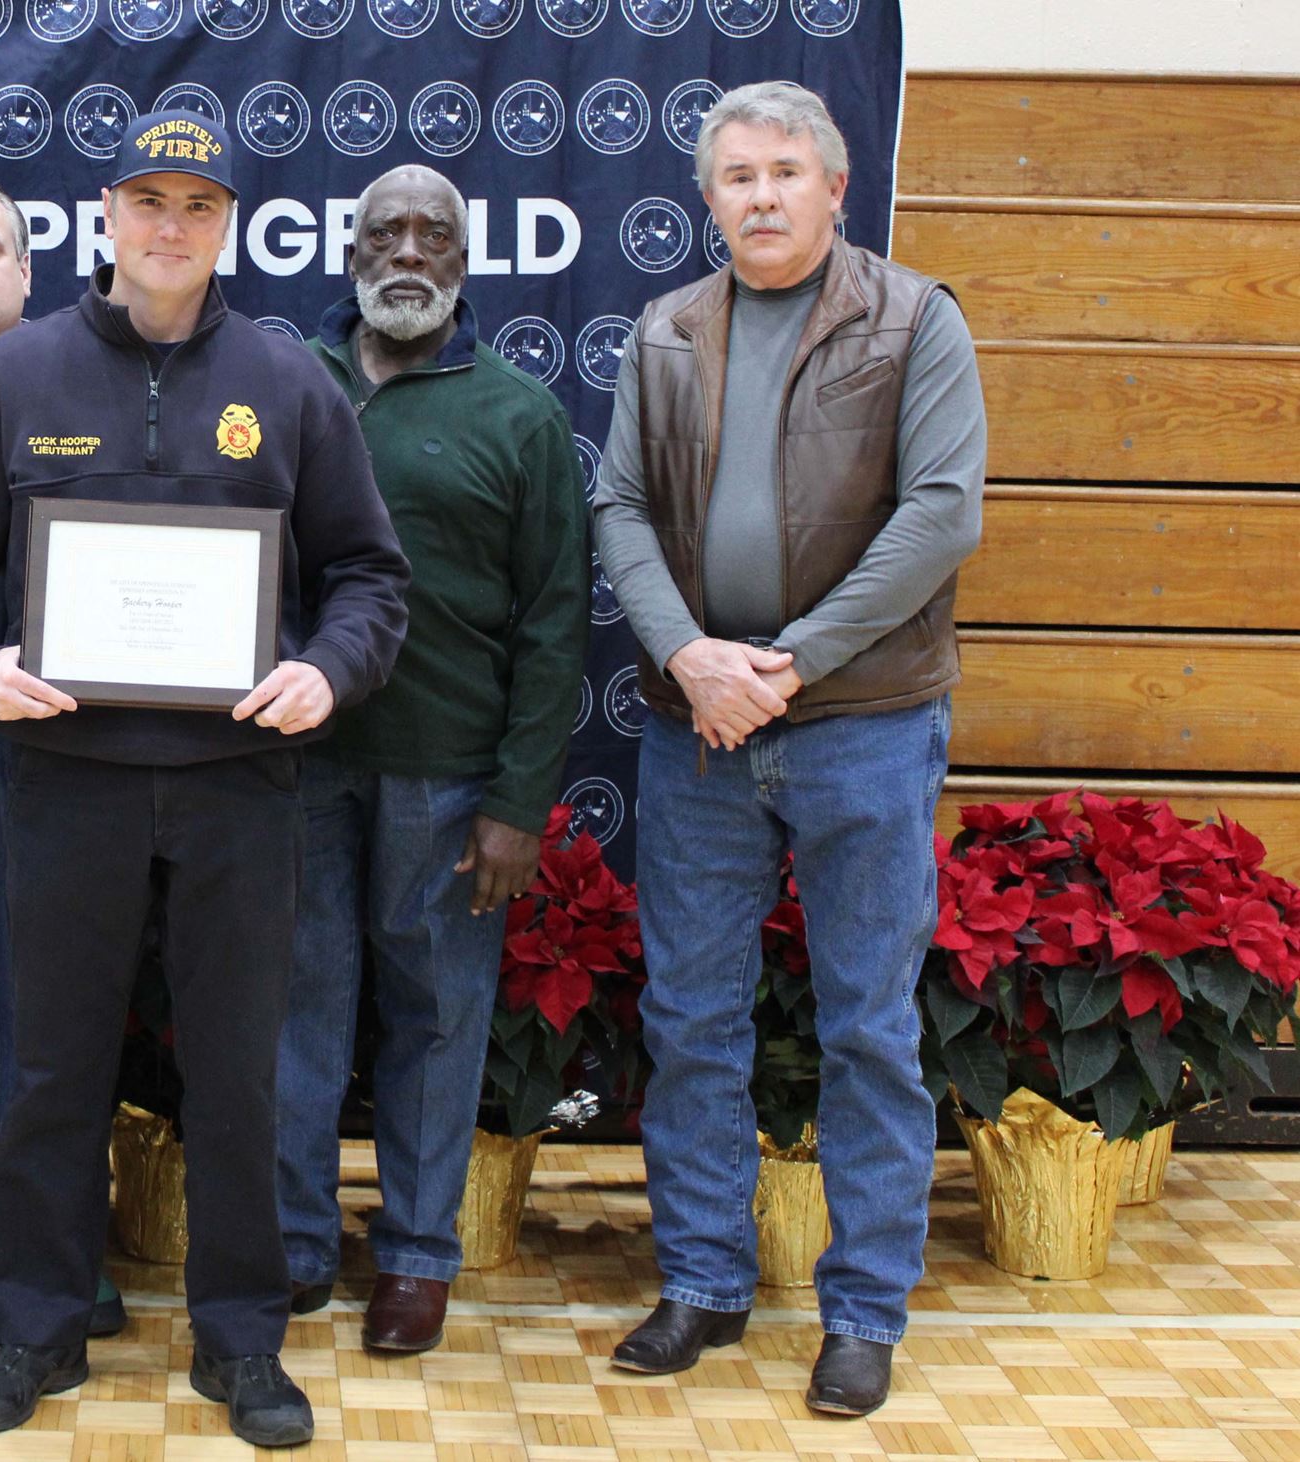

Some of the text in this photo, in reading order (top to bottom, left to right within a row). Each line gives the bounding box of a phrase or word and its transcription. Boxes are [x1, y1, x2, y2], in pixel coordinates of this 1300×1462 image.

[135, 119, 222, 156] SPRINGFIELD
[149, 139, 209, 163] FIRE
[28, 436, 100, 446] ZACK HOOPER
[33, 446, 96, 456] LIEUTENANT
[154, 598, 182, 610] Hooper
